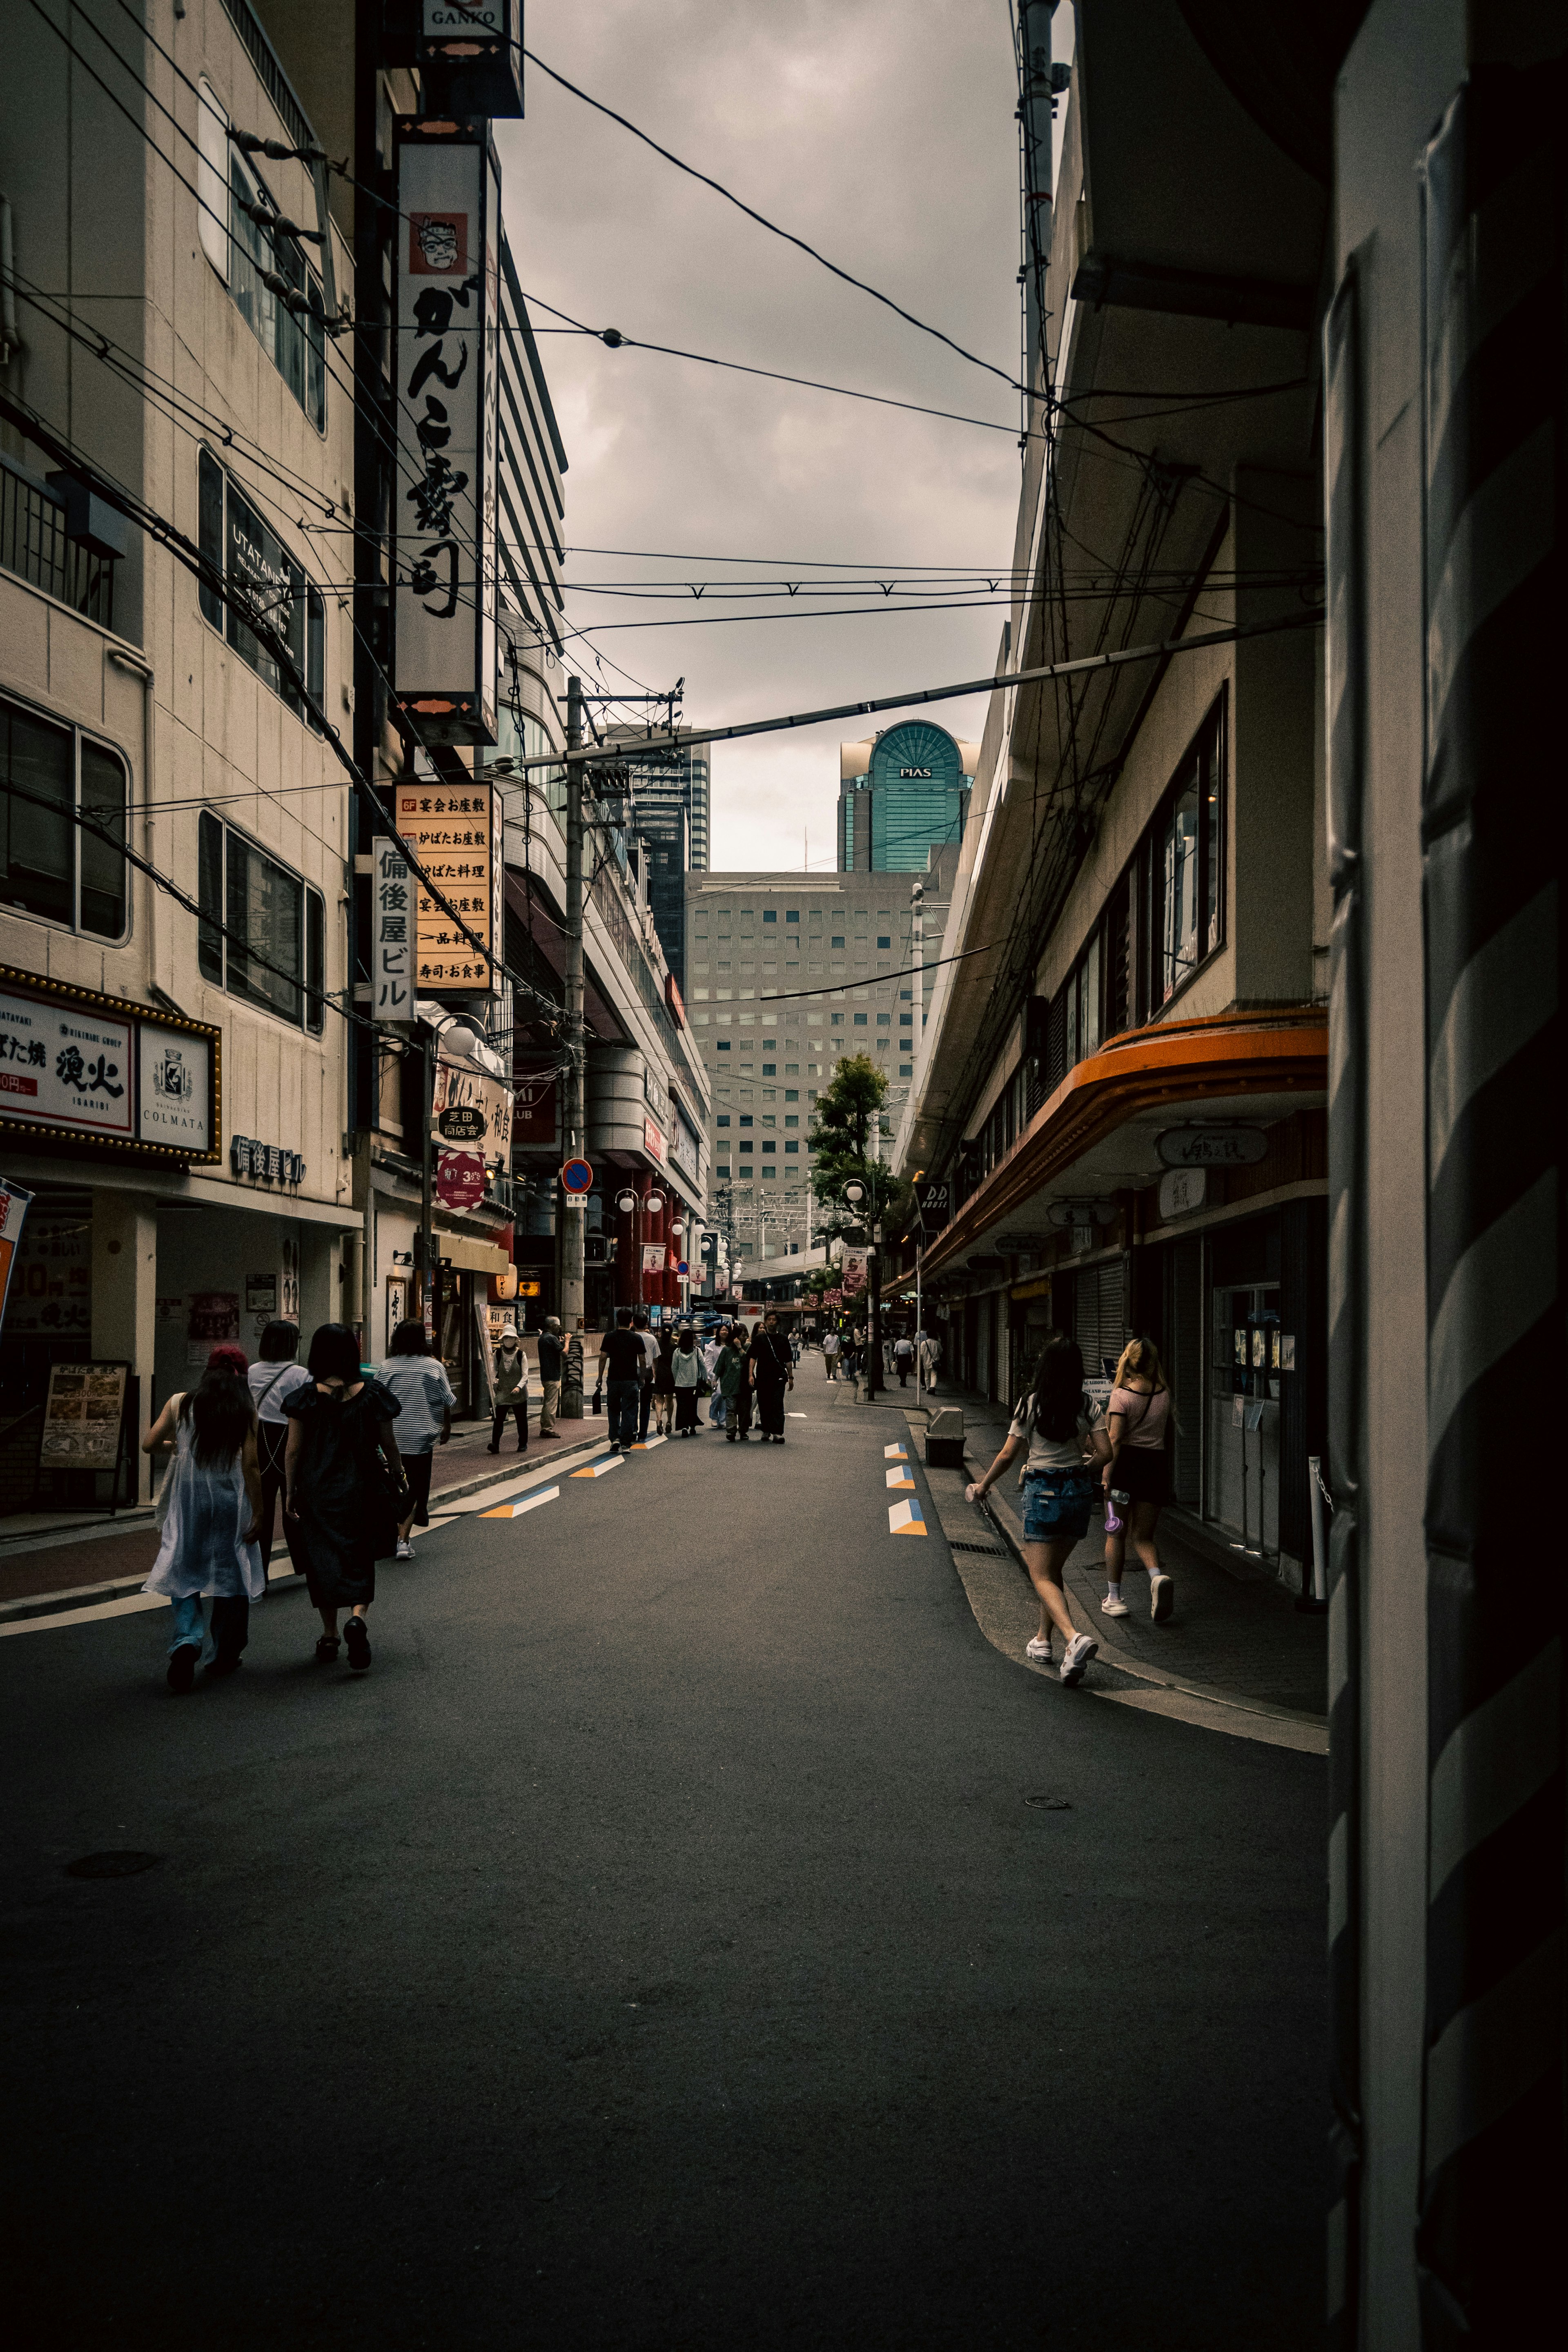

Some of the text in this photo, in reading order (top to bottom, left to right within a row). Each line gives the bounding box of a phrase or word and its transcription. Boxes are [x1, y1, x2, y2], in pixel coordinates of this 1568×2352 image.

[432, 11, 495, 24] GANKO
[233, 524, 294, 610] UTATANEYA
[900, 768, 931, 777] PIAS
[403, 800, 416, 811] 6F
[419, 798, 485, 813] 宴会お座敷
[419, 831, 486, 846] 炉ばたお座敷
[379, 850, 409, 1007] 備後屋ビル
[0, 1010, 31, 1026] ATAYAKI
[103, 1036, 122, 1048] GROUP
[56, 1045, 124, 1098] 漁火
[73, 1097, 109, 1111] ISARIBI
[144, 1109, 203, 1130] COLMATA
[449, 1111, 473, 1123] 芝田
[444, 1123, 479, 1136] 商店会
[231, 1135, 307, 1183] 備後屋ビル
[490, 1311, 512, 1323] 和食
